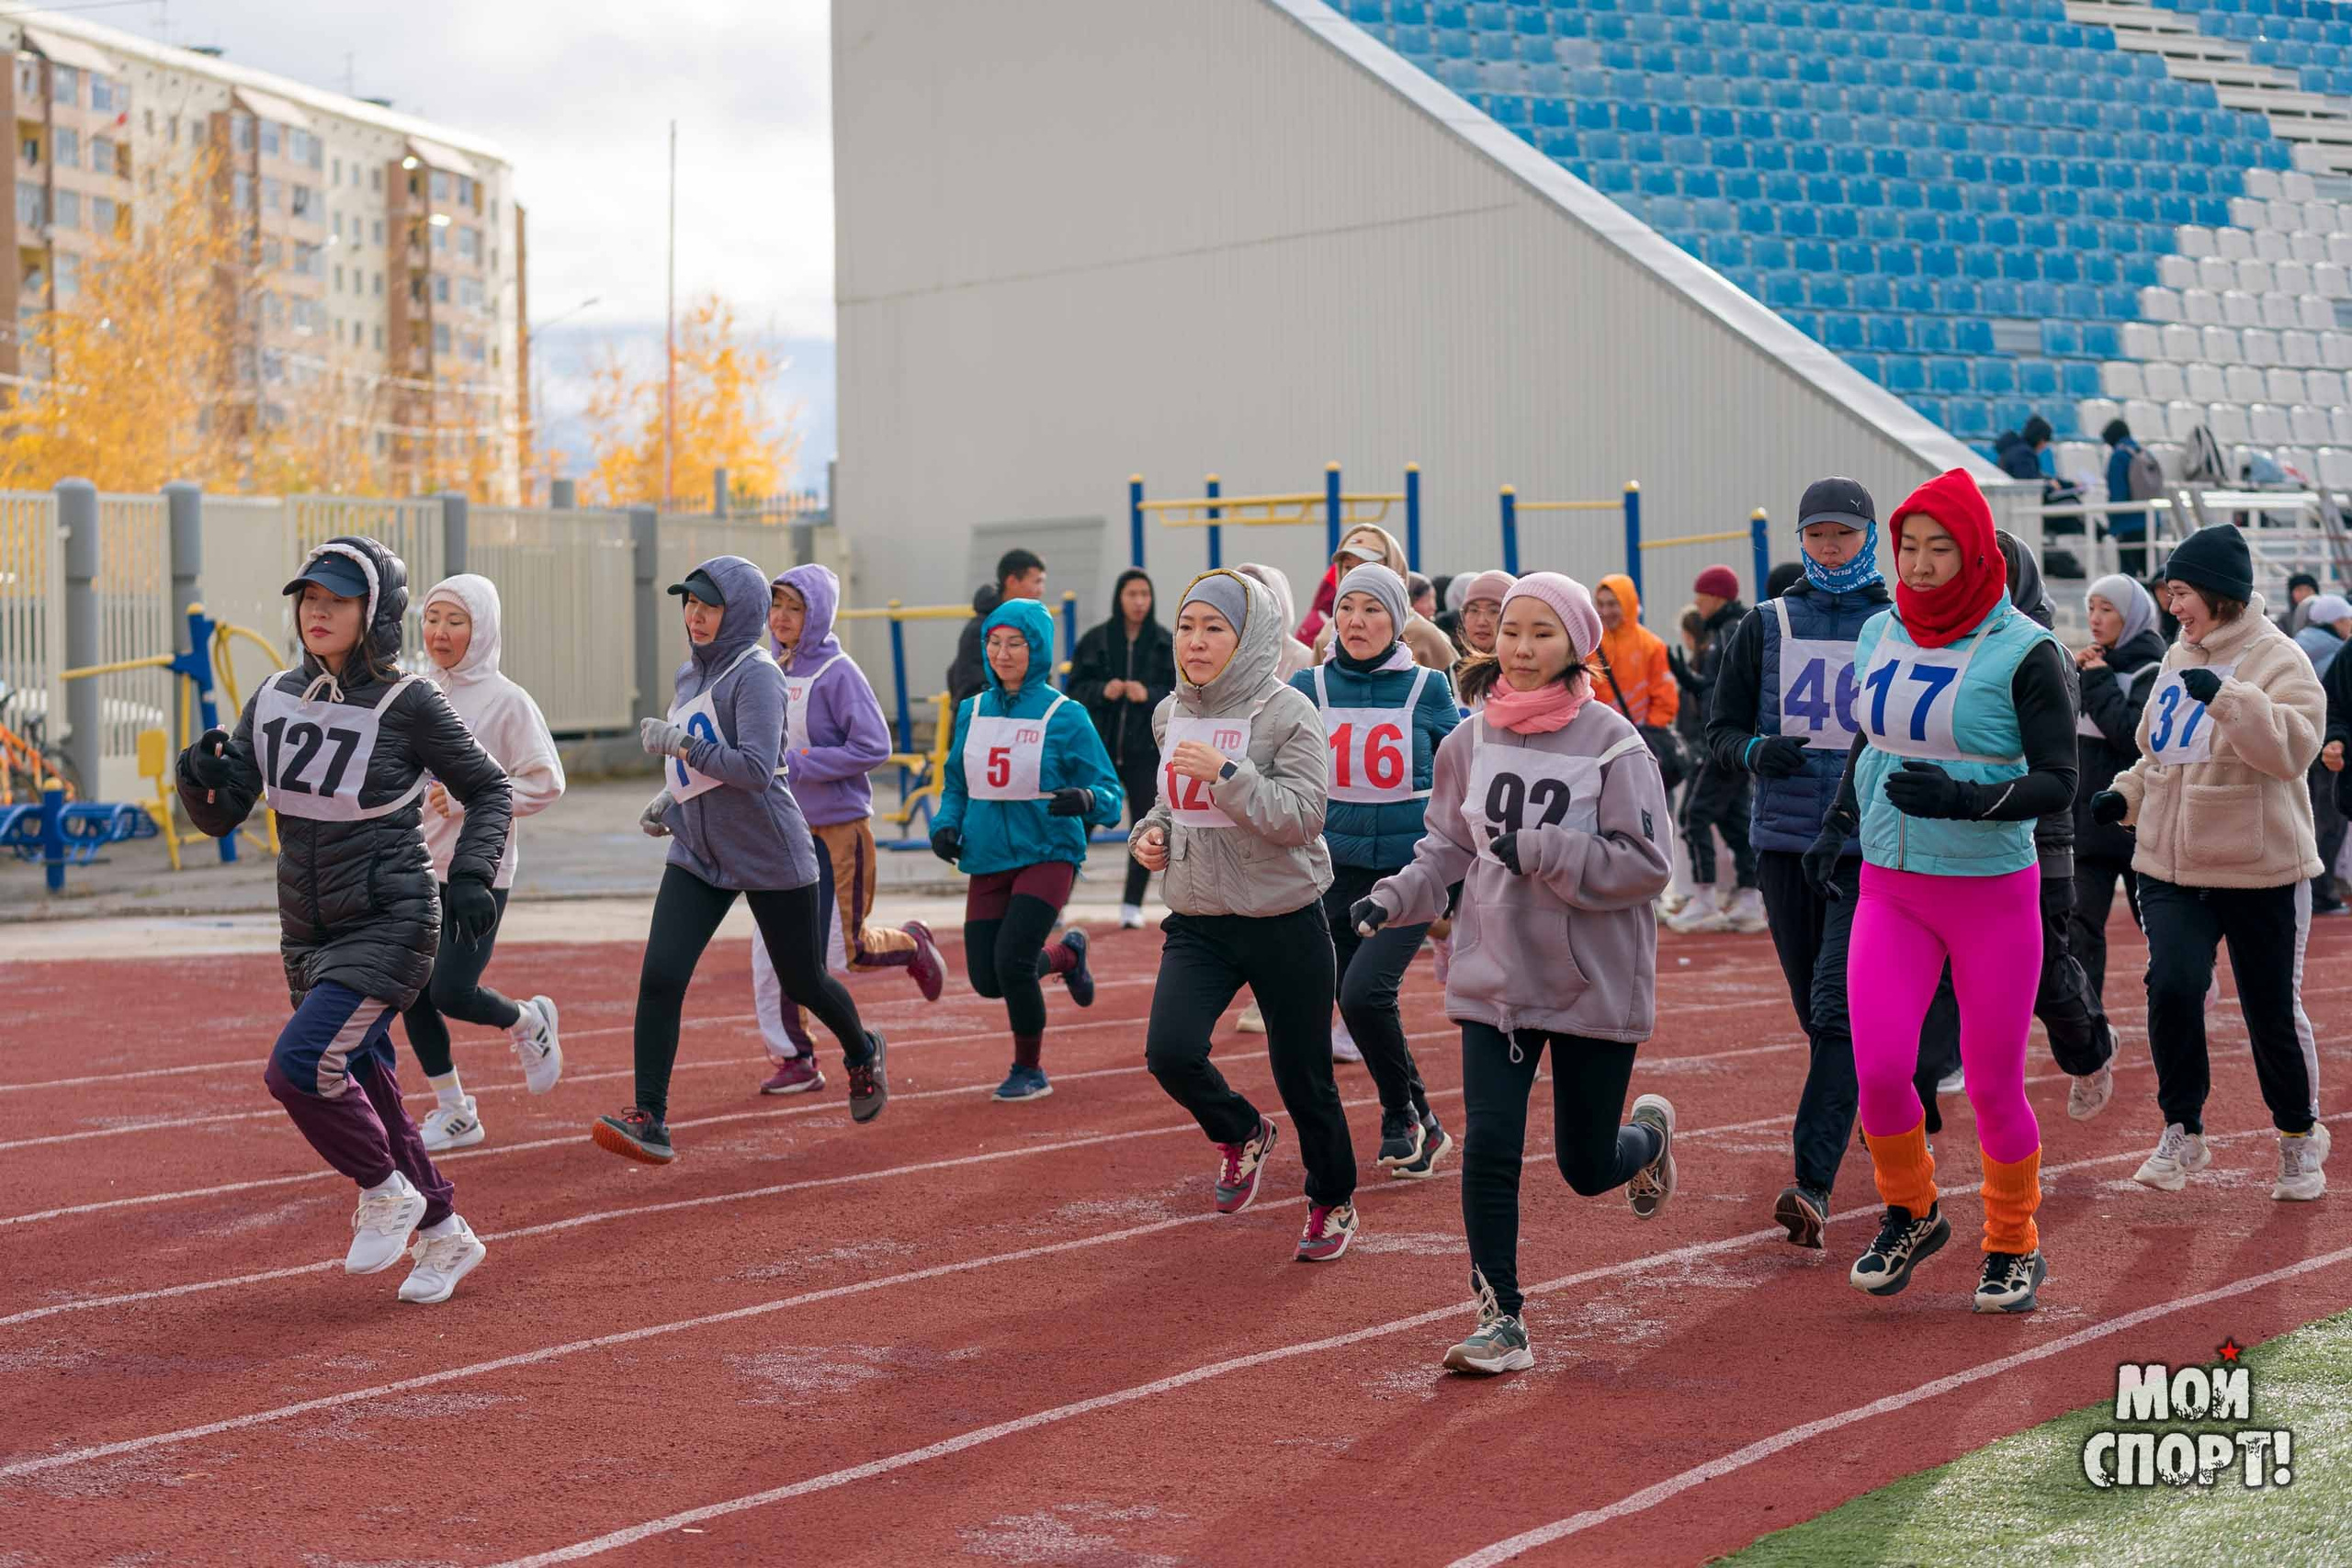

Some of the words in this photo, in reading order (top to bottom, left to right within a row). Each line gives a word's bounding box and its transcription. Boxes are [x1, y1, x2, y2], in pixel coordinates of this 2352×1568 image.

[1829, 568, 1851, 577] RUN
[1864, 658, 1959, 742] 17
[262, 716, 362, 798] 127
[1015, 728, 1040, 745] ГТО
[1212, 728, 1243, 750] ГТО
[1329, 722, 1405, 789] 16
[987, 747, 1012, 788] 5
[1164, 761, 1216, 811] 12
[1485, 772, 1571, 840] 92
